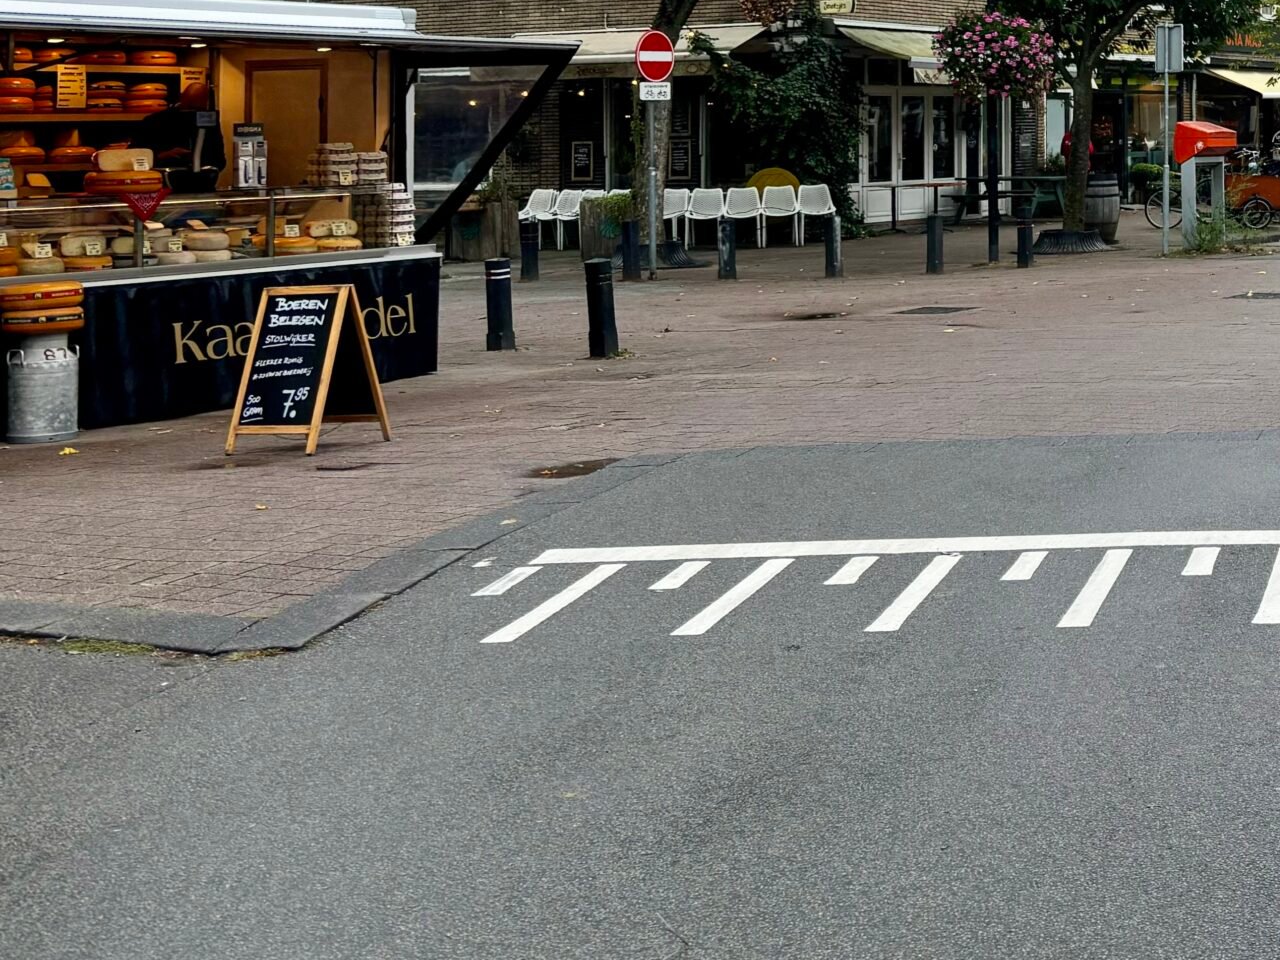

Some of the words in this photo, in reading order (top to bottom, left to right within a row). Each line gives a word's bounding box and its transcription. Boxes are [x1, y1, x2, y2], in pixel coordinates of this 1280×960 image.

[275, 297, 329, 312] BOEREN
[267, 314, 326, 328] BELEGEN
[43, 348, 68, 361] 87
[246, 394, 262, 405] 500
